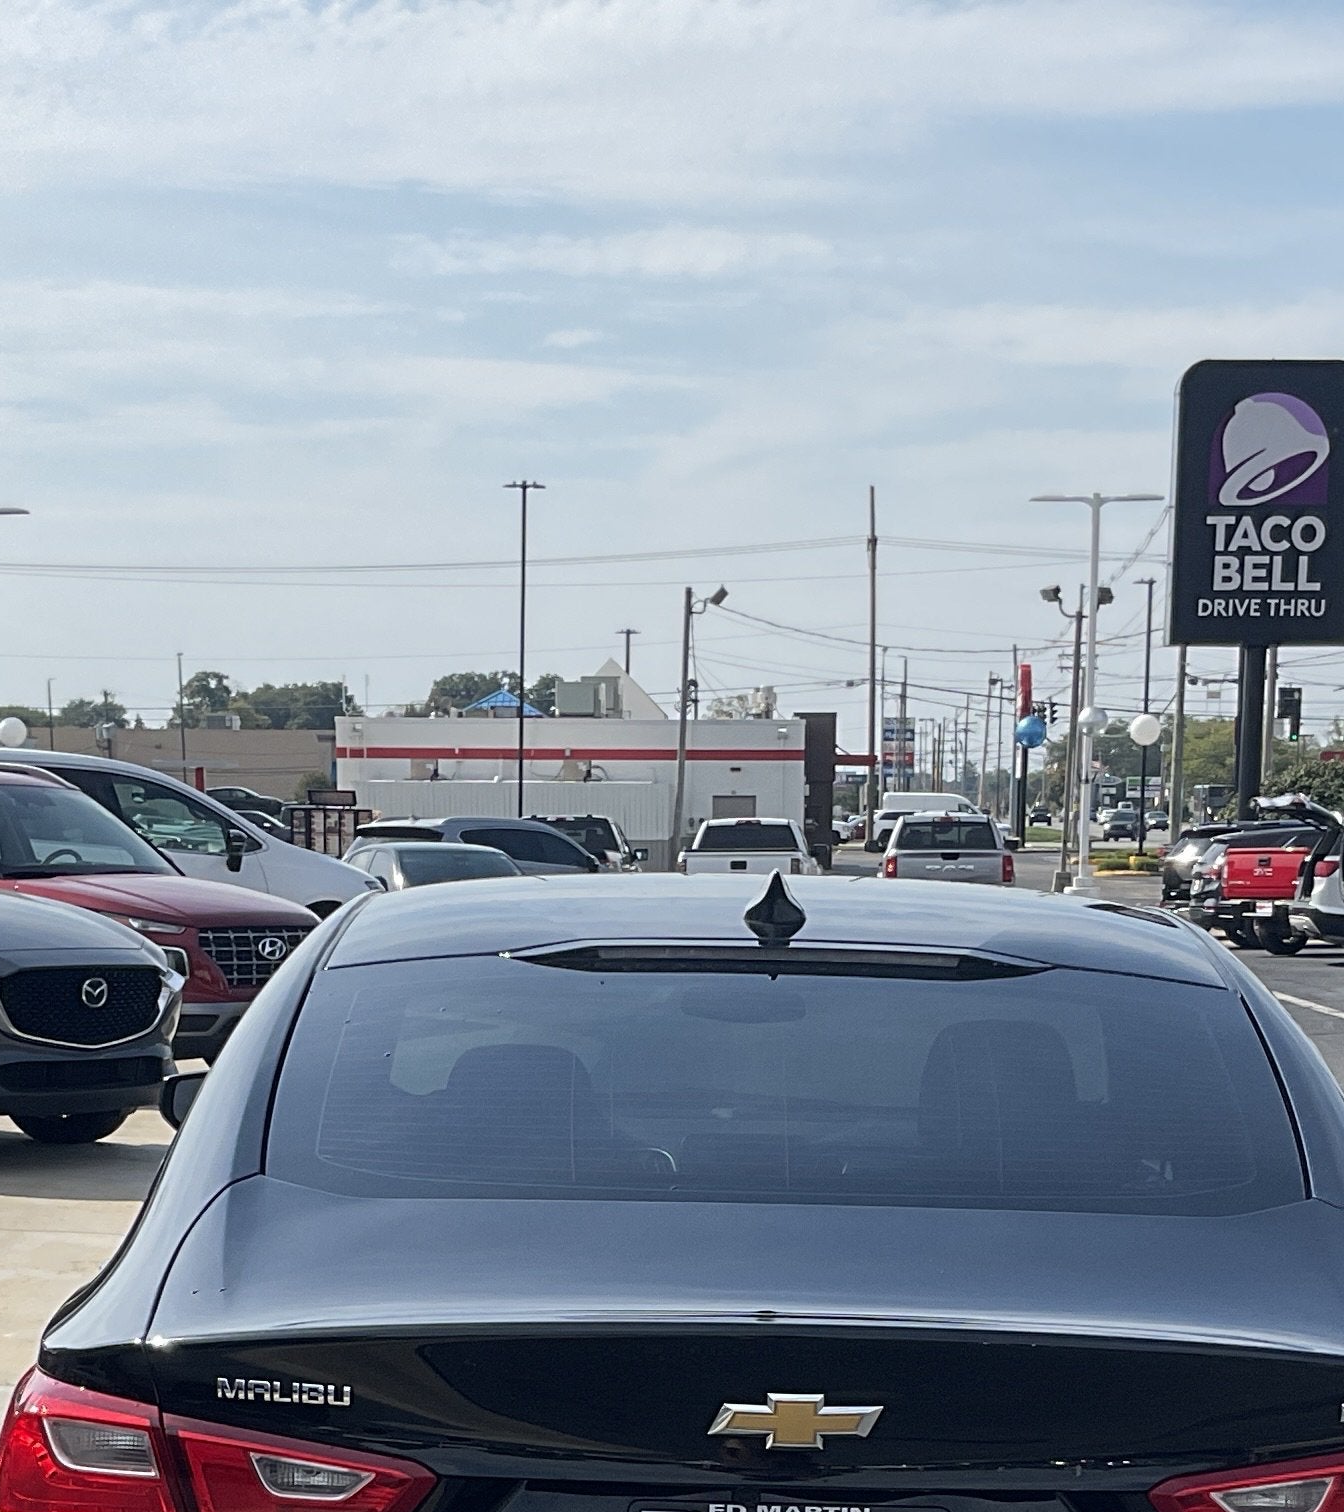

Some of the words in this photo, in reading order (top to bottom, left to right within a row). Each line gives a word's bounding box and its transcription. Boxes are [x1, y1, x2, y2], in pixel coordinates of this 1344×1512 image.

[1206, 515, 1326, 552] TACO
[1212, 555, 1321, 591] BELL
[1197, 599, 1261, 617] DRIVE
[1267, 599, 1326, 617] THRU
[216, 1377, 352, 1407] MALIBU
